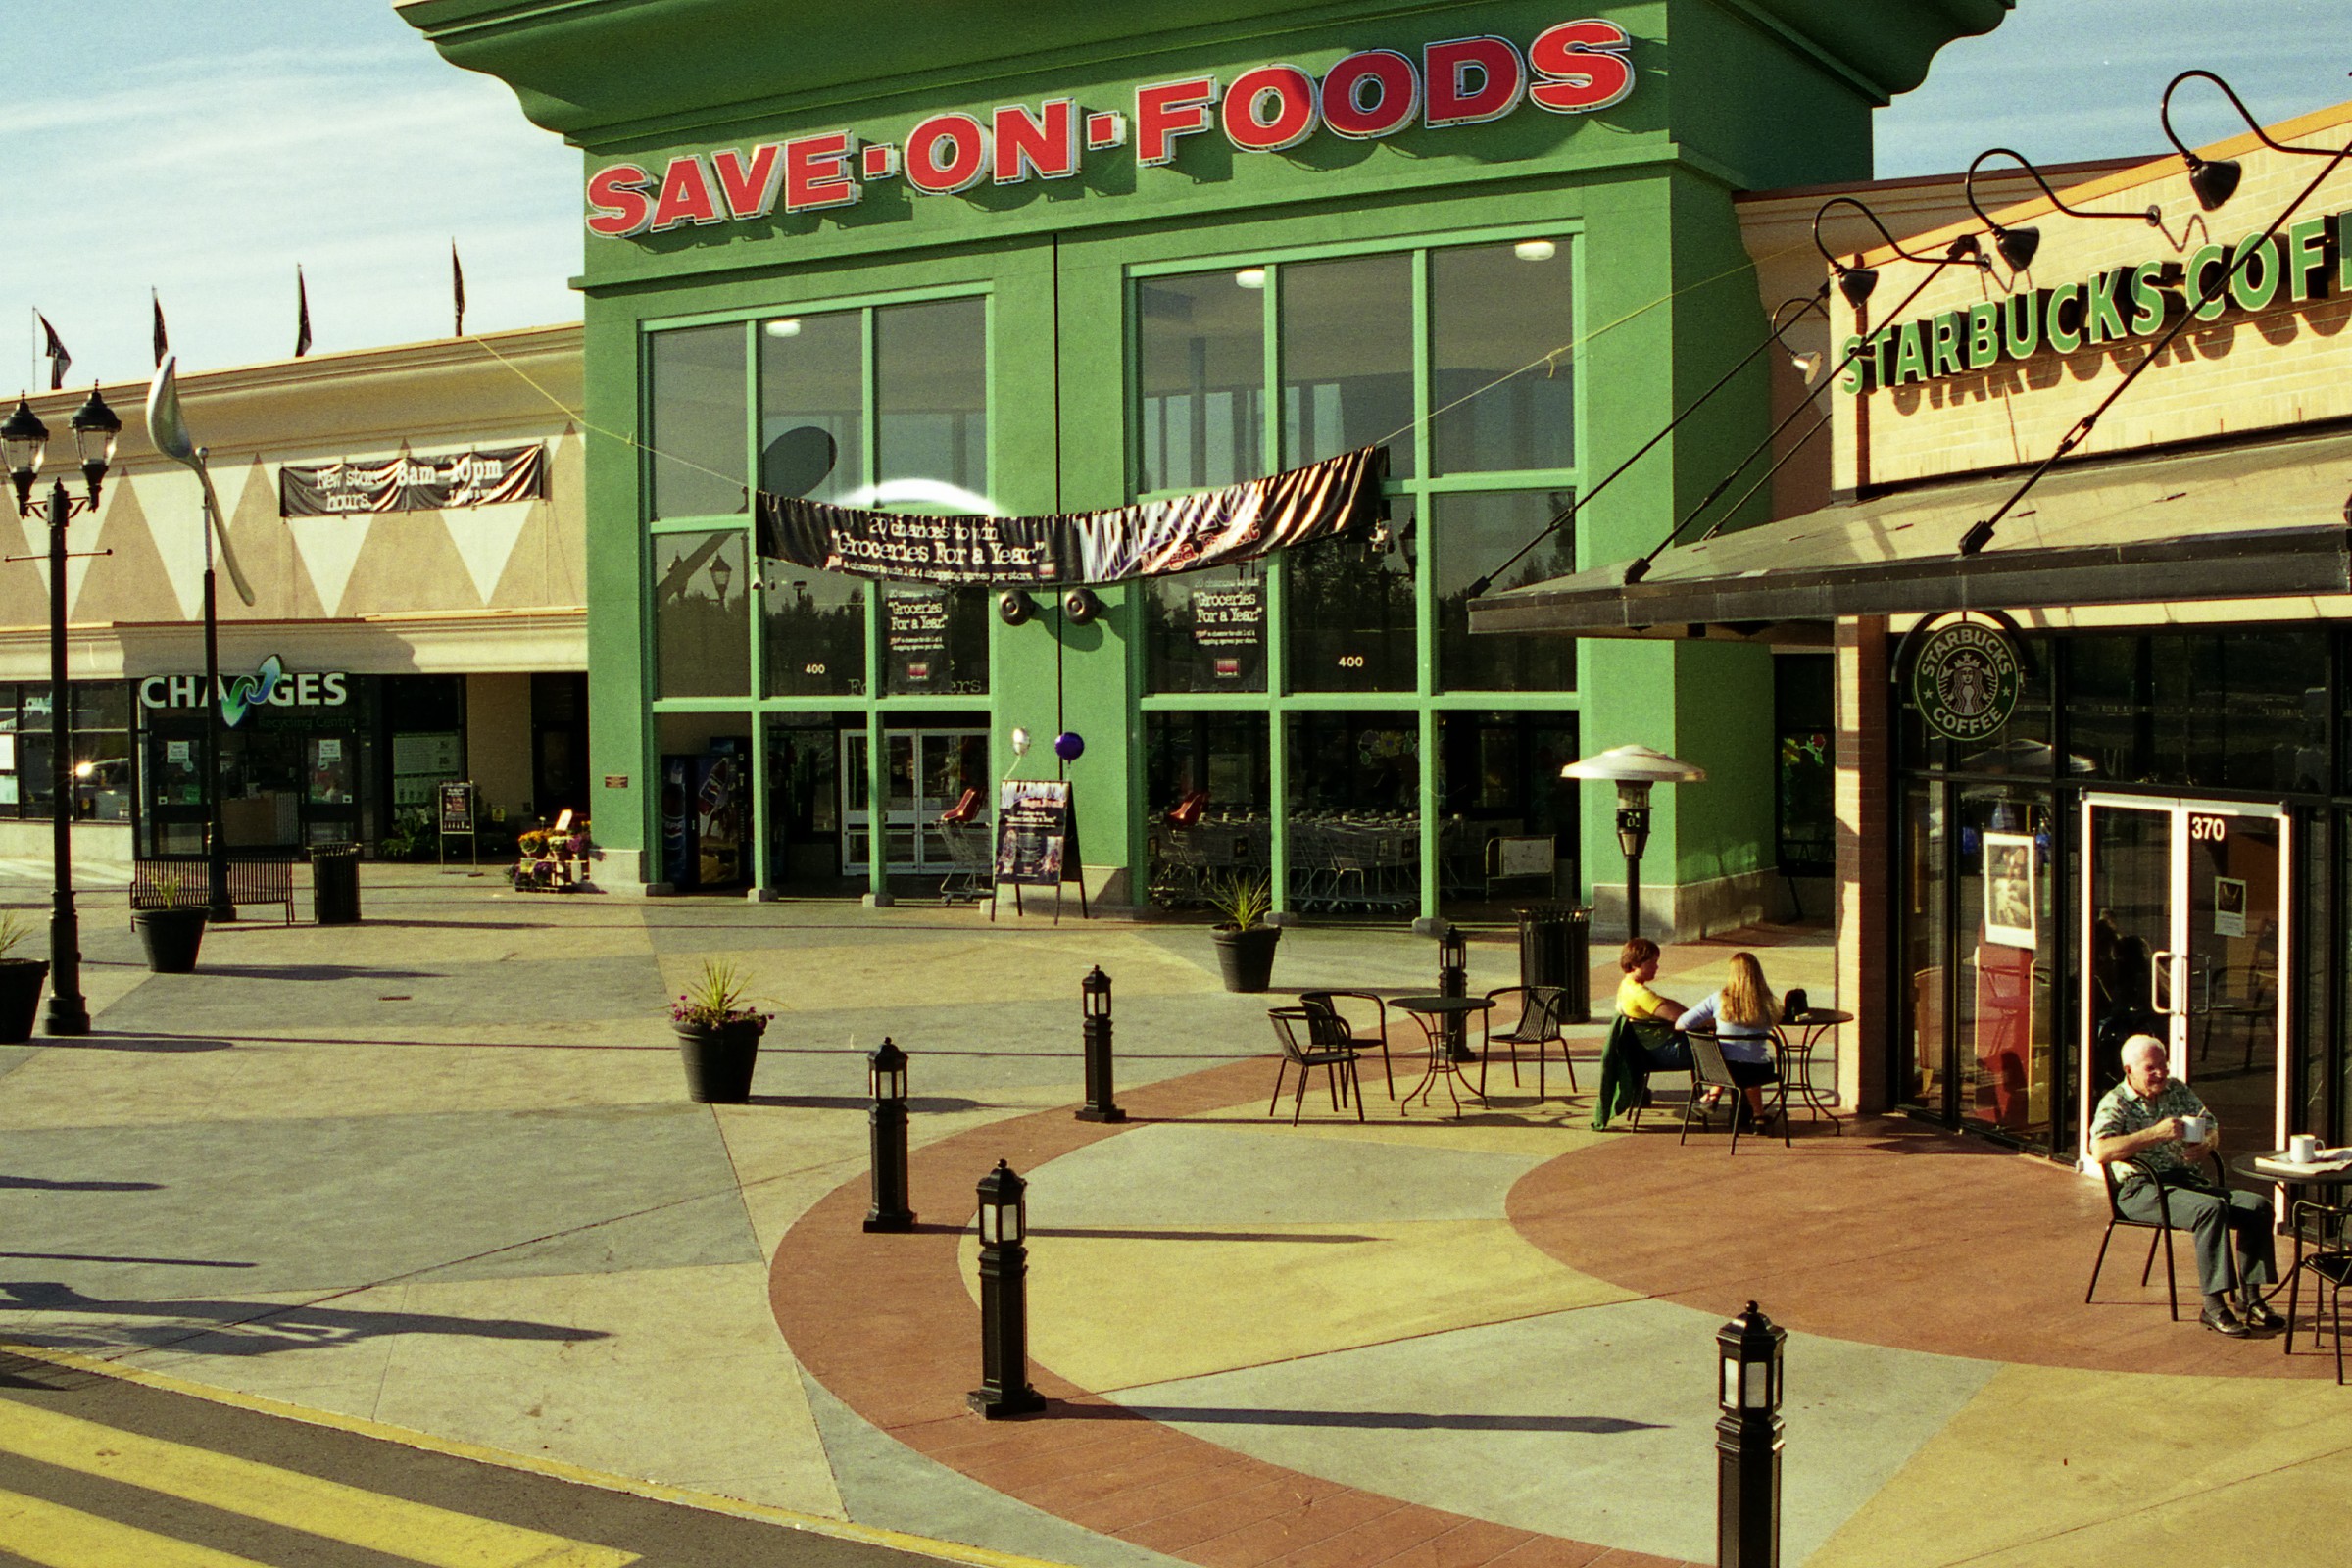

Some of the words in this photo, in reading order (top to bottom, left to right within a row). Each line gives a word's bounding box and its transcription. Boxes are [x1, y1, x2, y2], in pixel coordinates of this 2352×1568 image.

[1842, 260, 2165, 395] STARBUCKS
[316, 470, 342, 489] New
[869, 517, 888, 539] 20
[890, 520, 950, 539] chances
[953, 522, 969, 540] to
[934, 542, 968, 564] For
[972, 548, 985, 564] a
[890, 616, 909, 631] For
[911, 619, 918, 630] a
[1196, 609, 1218, 623] For
[1220, 611, 1228, 622] a
[1338, 657, 1364, 667] 400
[1922, 628, 2012, 677] STARBUCKS
[806, 663, 825, 674] 400
[1933, 706, 2002, 734] COFFEE
[2191, 816, 2225, 841] 370
